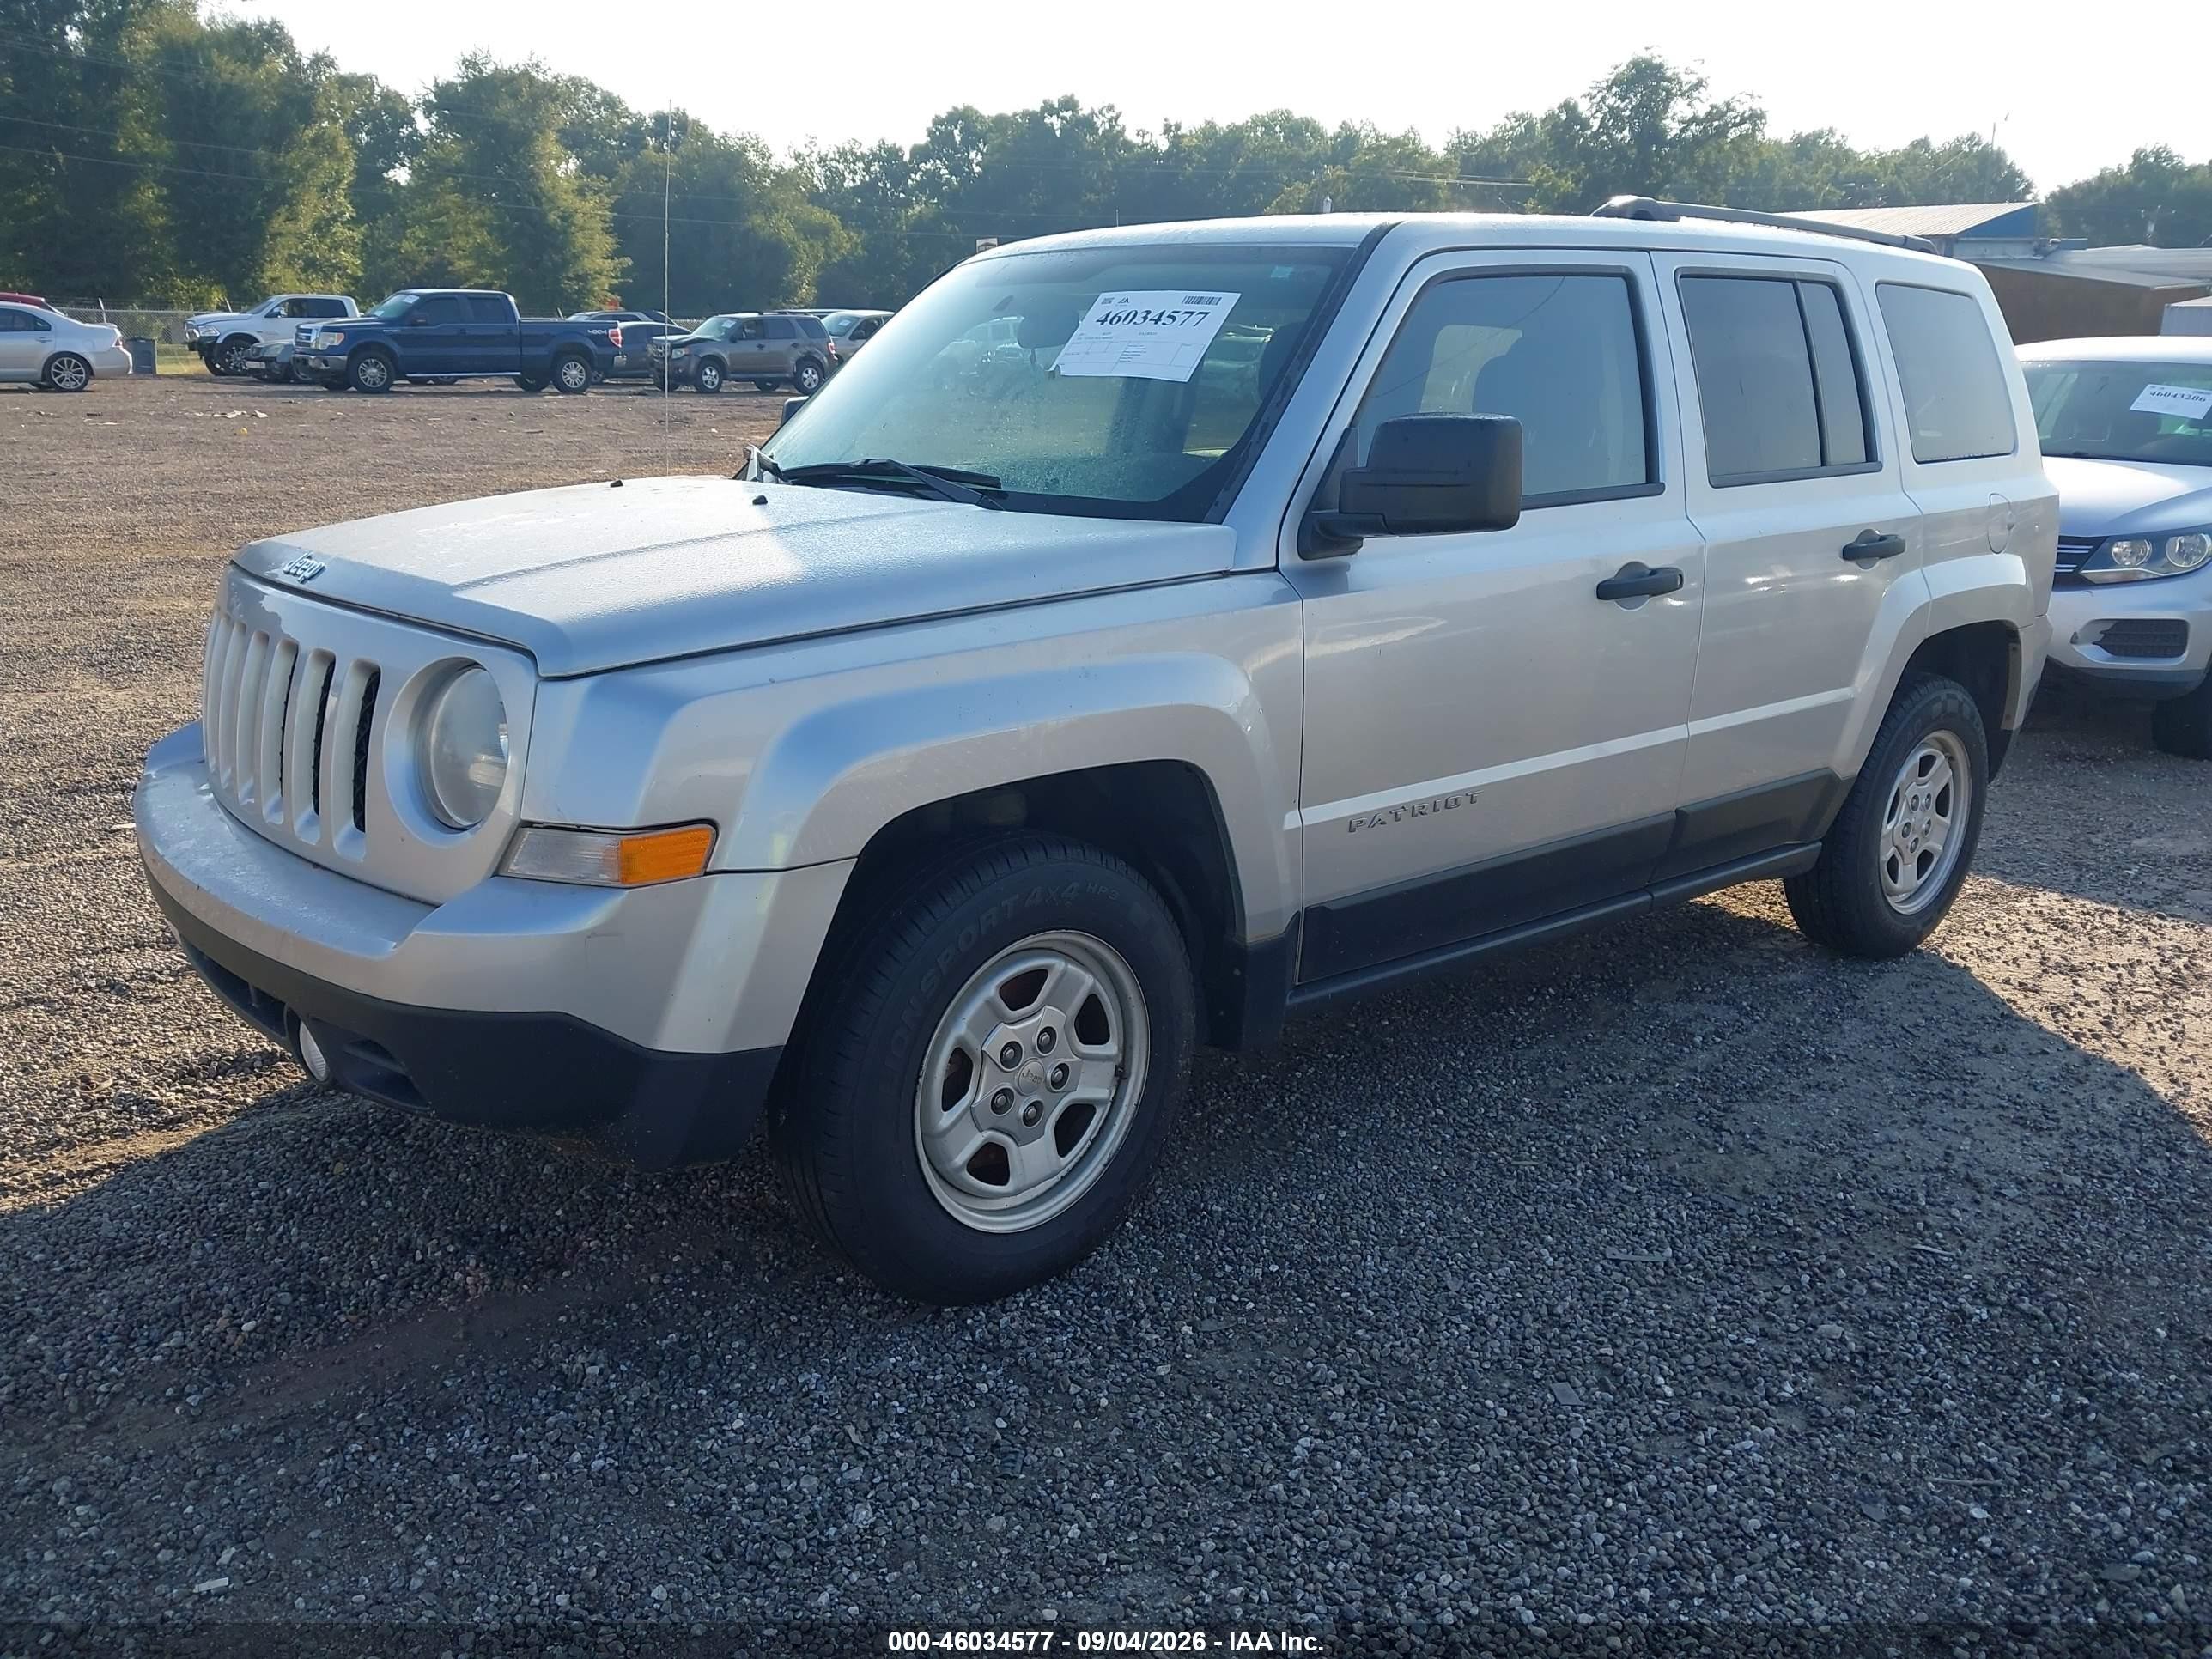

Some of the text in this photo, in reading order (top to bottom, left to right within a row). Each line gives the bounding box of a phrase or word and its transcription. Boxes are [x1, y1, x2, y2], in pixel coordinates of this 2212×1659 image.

[1096, 309, 1212, 327] 46034577
[283, 552, 325, 584] Jeep
[1348, 790, 1484, 833] PATRIOT
